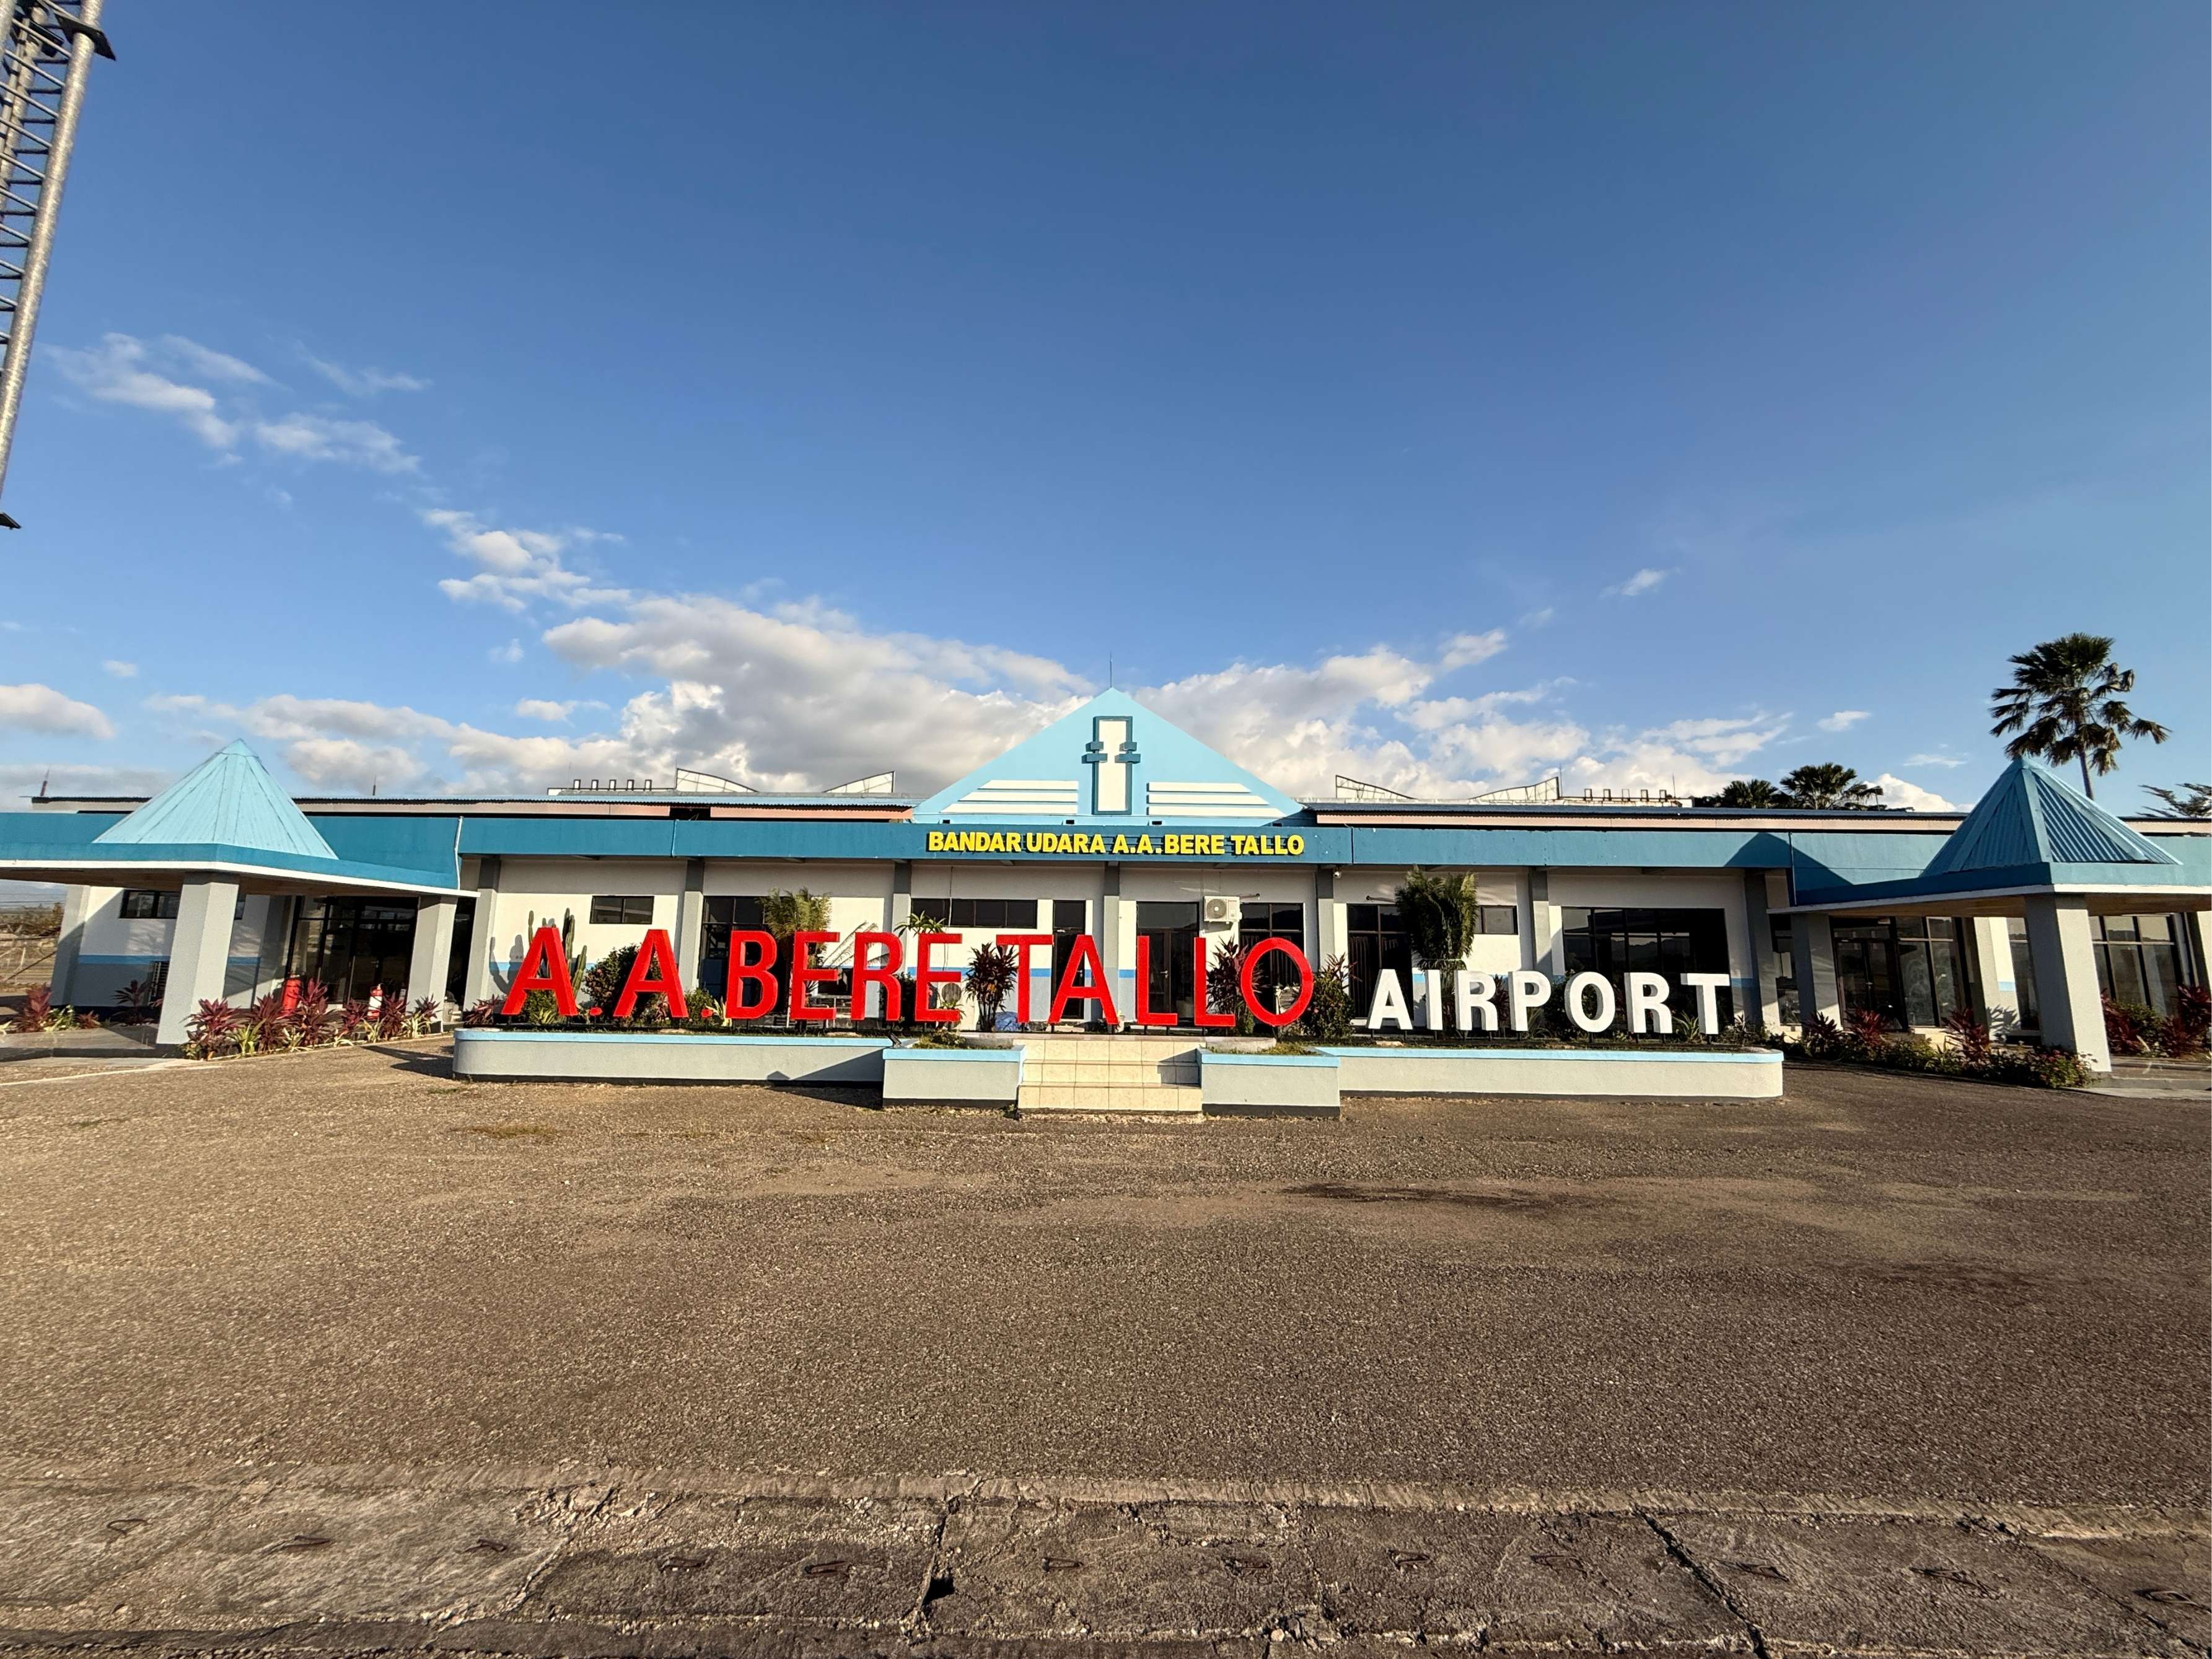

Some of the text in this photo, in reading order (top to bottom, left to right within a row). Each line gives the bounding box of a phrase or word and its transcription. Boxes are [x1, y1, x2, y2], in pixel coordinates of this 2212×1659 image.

[929, 831, 1022, 852] BANDAR
[1026, 832, 1107, 853] UDARA
[1231, 834, 1305, 855] TALLO
[996, 934, 1314, 1027] TALLO
[1366, 969, 1731, 1035] AIRPORT
